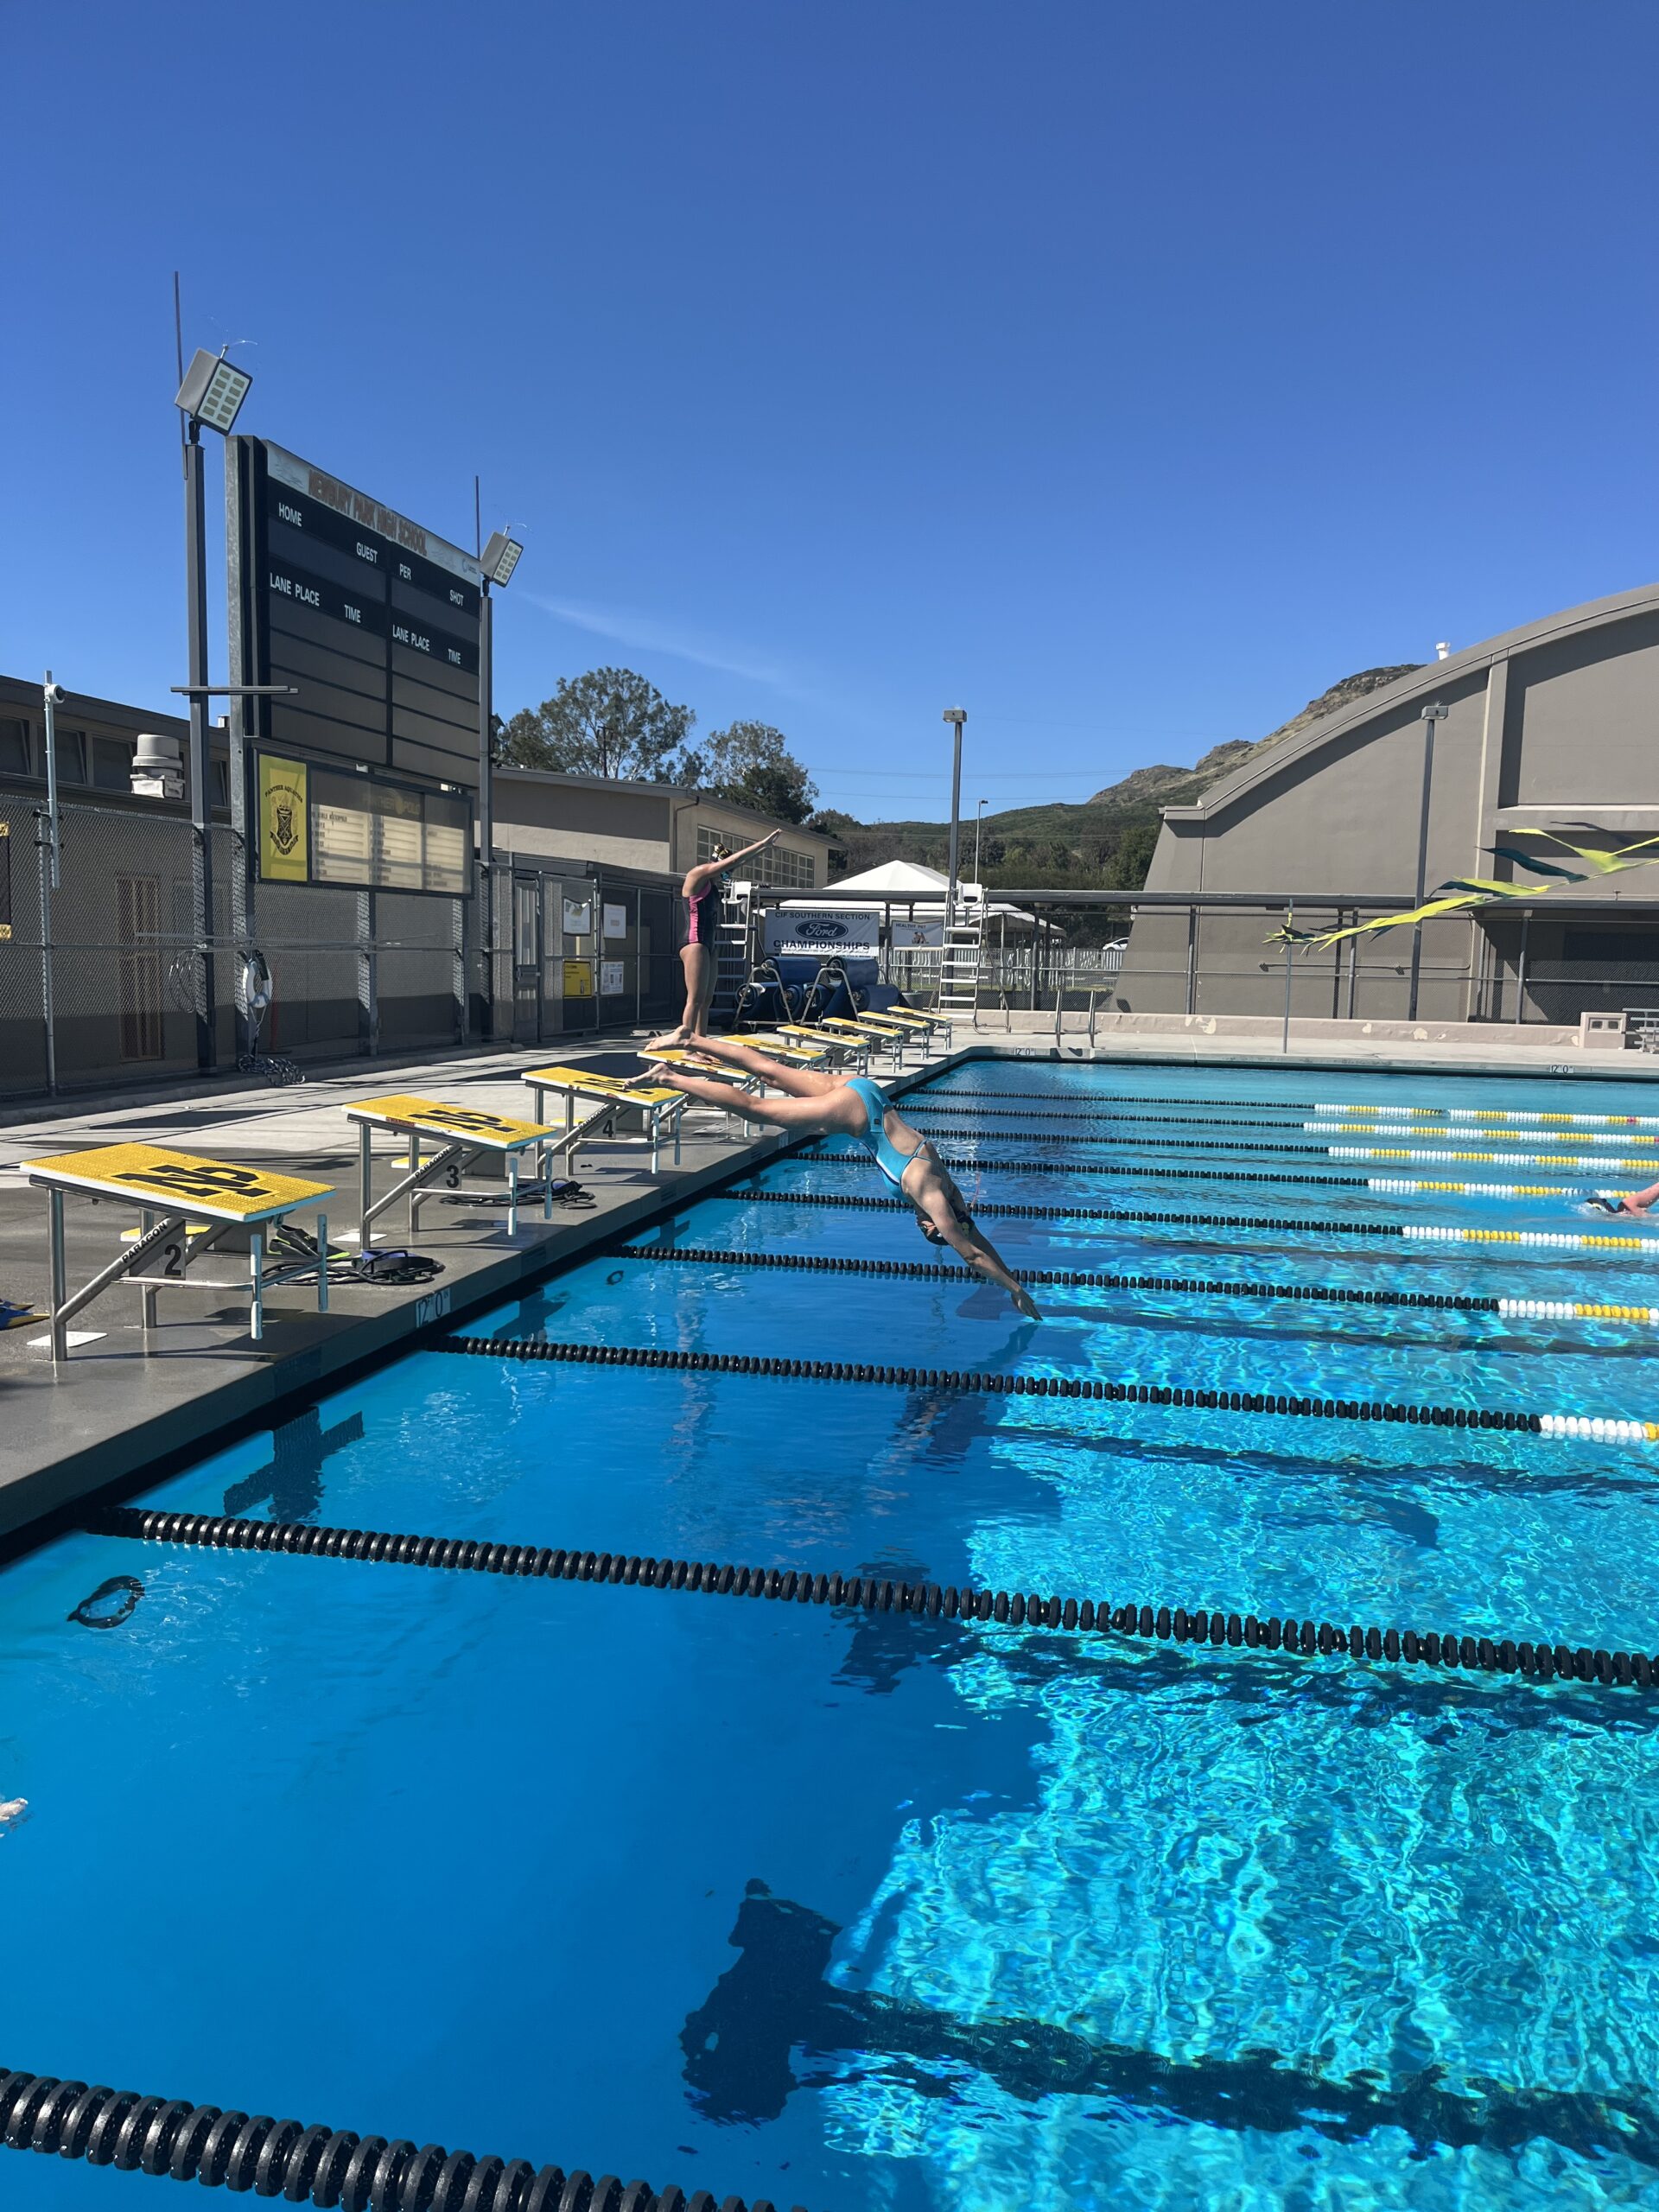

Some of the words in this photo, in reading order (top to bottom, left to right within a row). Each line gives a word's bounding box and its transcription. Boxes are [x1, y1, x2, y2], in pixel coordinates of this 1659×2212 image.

[278, 502, 302, 527] HOME
[356, 542, 378, 564] GUEST
[399, 563, 411, 581] PER
[270, 572, 292, 595] LANE
[295, 583, 320, 607] PLACE
[449, 589, 464, 607] SHOT
[344, 604, 361, 624] TIME
[392, 624, 409, 643] LANE
[410, 632, 430, 652] PLACE
[448, 649, 461, 665] TIME
[790, 912, 833, 920] SOUTHERN
[835, 912, 871, 921] SECTION
[805, 922, 838, 937] Ford
[773, 939, 870, 950] CHAMPIONSHIPS
[602, 1120, 613, 1138] 4
[415, 1147, 450, 1179] PARAGON
[446, 1165, 459, 1188] 3
[122, 1221, 168, 1264] PARAGON
[164, 1244, 181, 1276] 2
